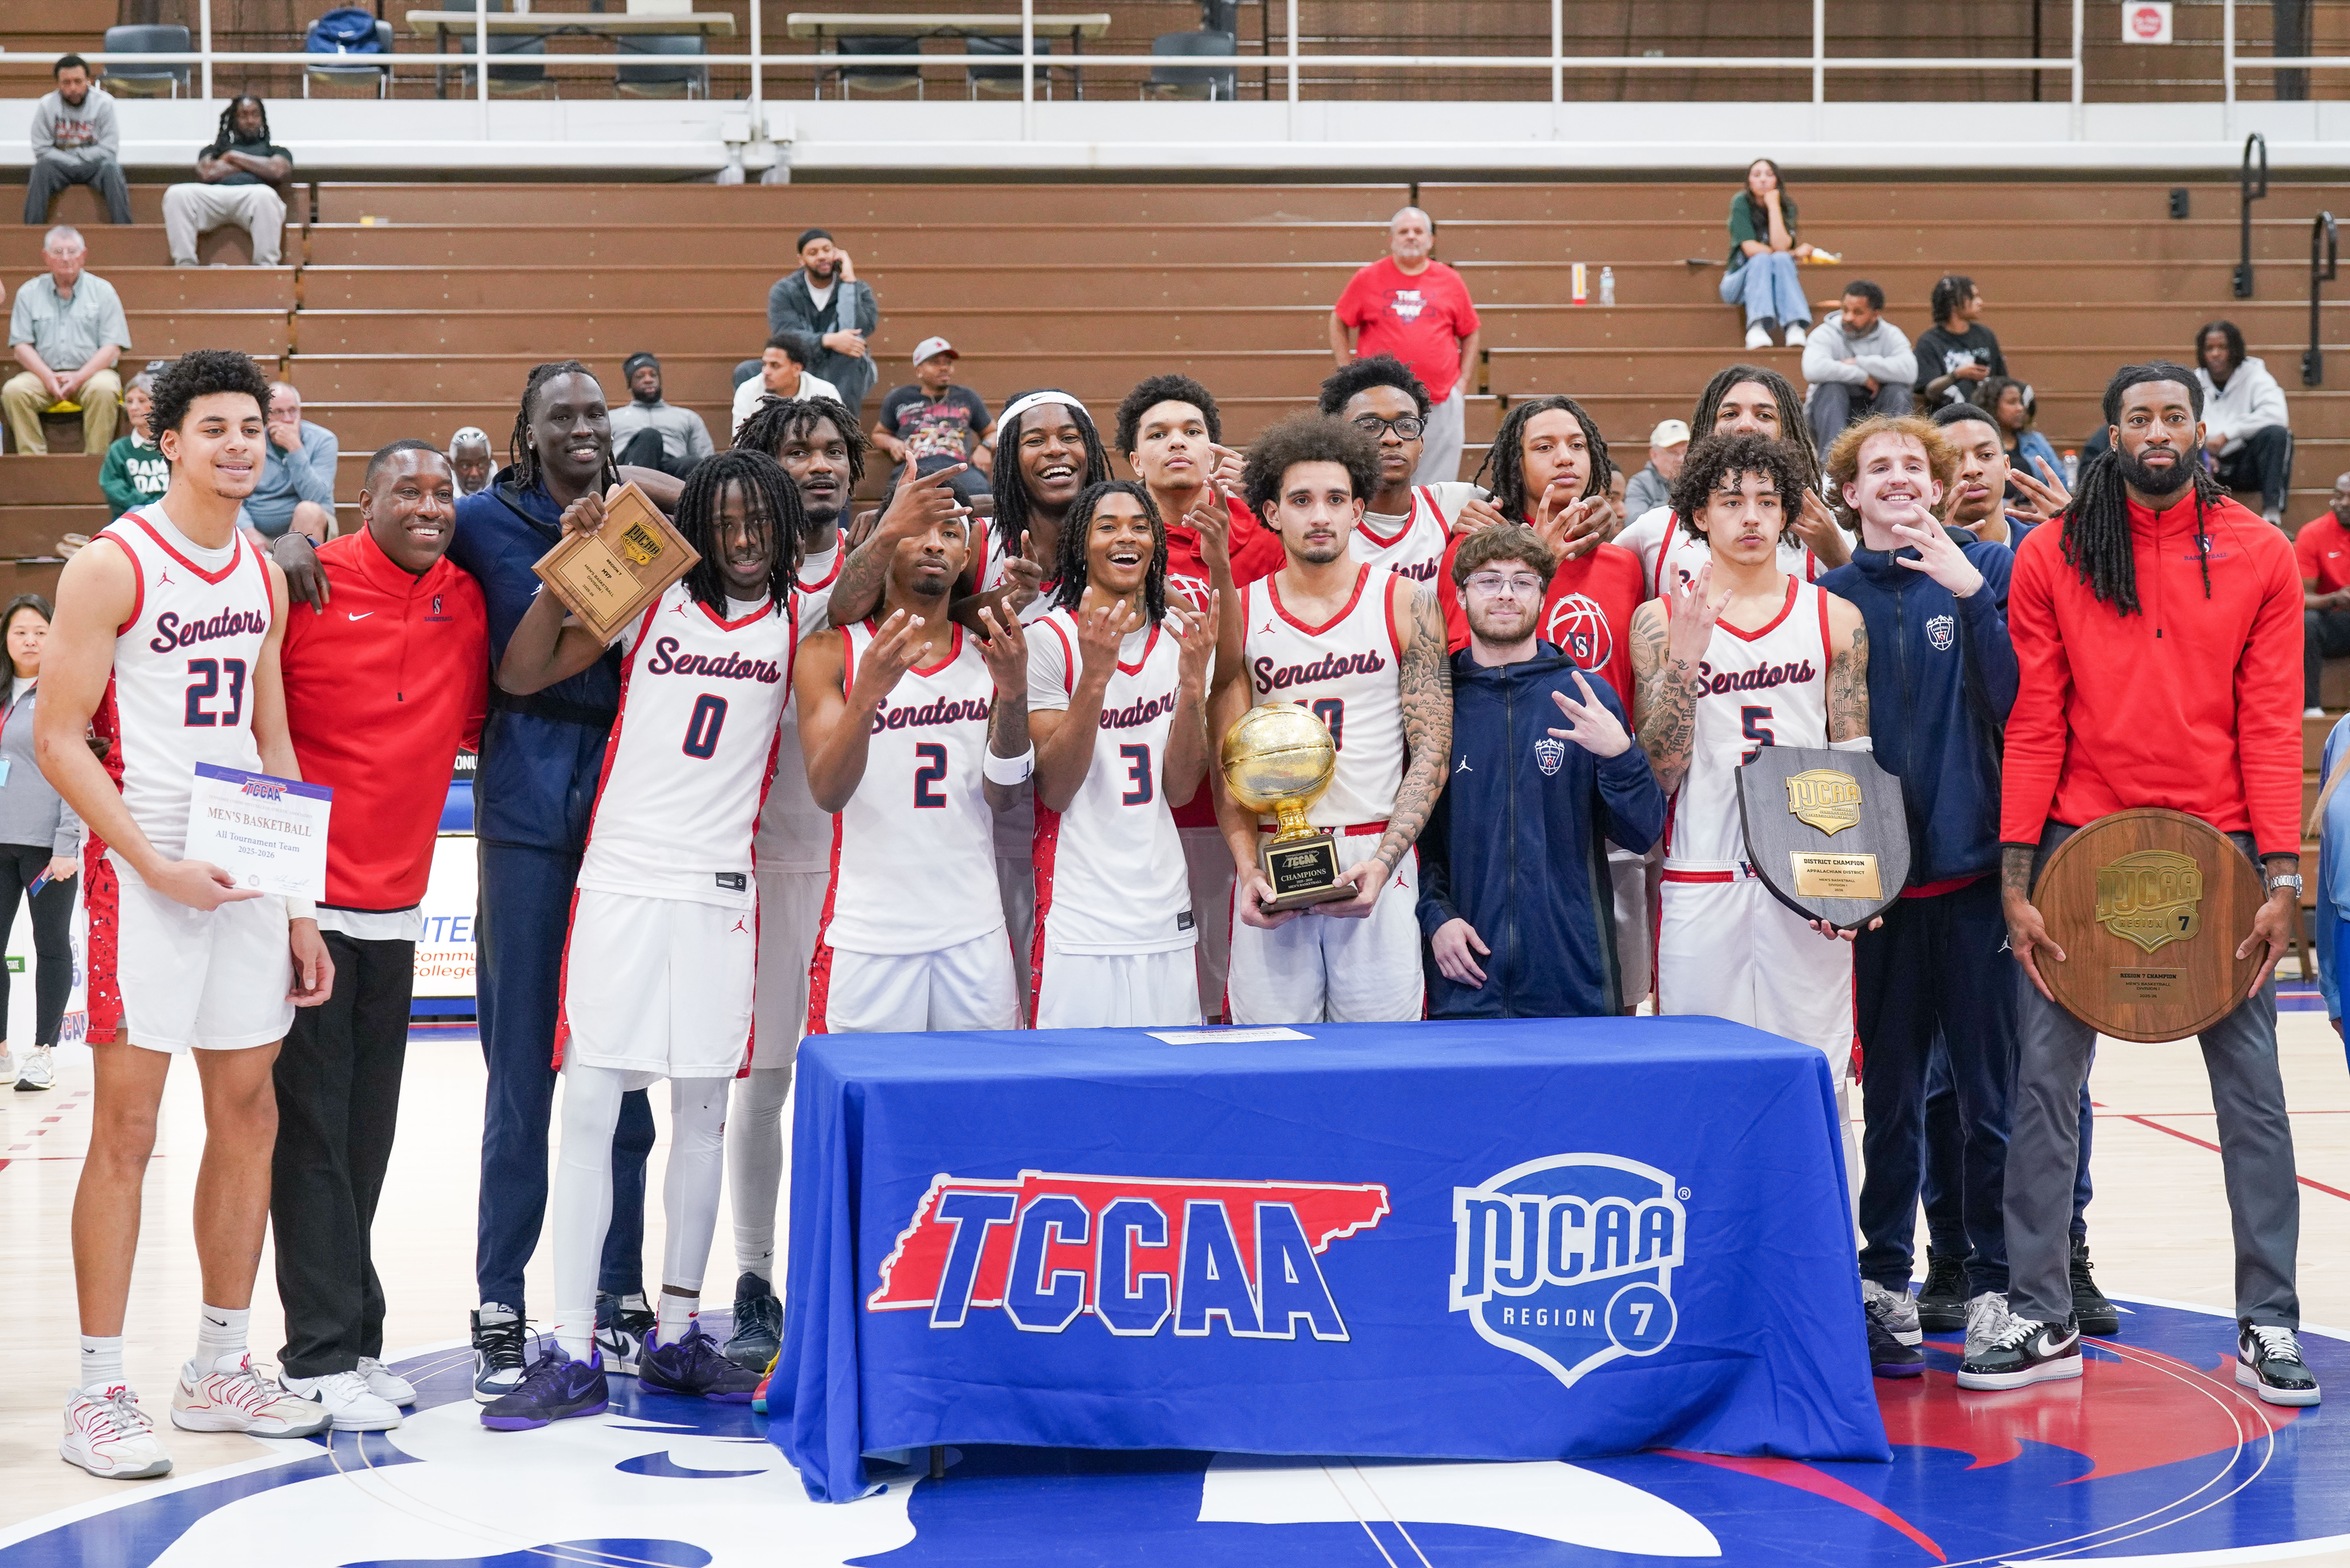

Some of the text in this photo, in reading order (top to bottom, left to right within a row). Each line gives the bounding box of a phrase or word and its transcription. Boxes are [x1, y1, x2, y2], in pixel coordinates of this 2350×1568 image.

[602, 568, 612, 579] MVP
[149, 606, 266, 654] Senators
[647, 636, 782, 684] Senators
[1254, 649, 1386, 695] Senators
[1697, 659, 1816, 699] Senators
[184, 658, 247, 727] 23
[1099, 687, 1178, 730] enator
[682, 693, 729, 760] 0
[870, 696, 989, 735] Senators
[1293, 698, 1345, 752] 0
[1741, 706, 1775, 767] 5
[454, 755, 478, 770] ONU
[914, 742, 947, 808] 2
[1120, 743, 1154, 806] 3
[246, 782, 282, 802] TCCAA
[1790, 780, 1859, 809] NJCAA
[207, 806, 241, 823] MEN'S
[243, 814, 312, 837] BASKETBALL
[216, 830, 300, 853] All Tournament Team
[238, 846, 275, 859] 2025-2026
[1286, 853, 1318, 868] TCCAA
[1280, 868, 1327, 882] CHAMPIONS
[2099, 869, 2199, 916] NJCAA
[2119, 918, 2163, 928] REGION
[2178, 915, 2190, 931] 7
[929, 1188, 1352, 1343] TCCAA
[1460, 1197, 1677, 1300] NJCAA
[1502, 1307, 1596, 1327] REGION
[1629, 1303, 1655, 1336] 7
